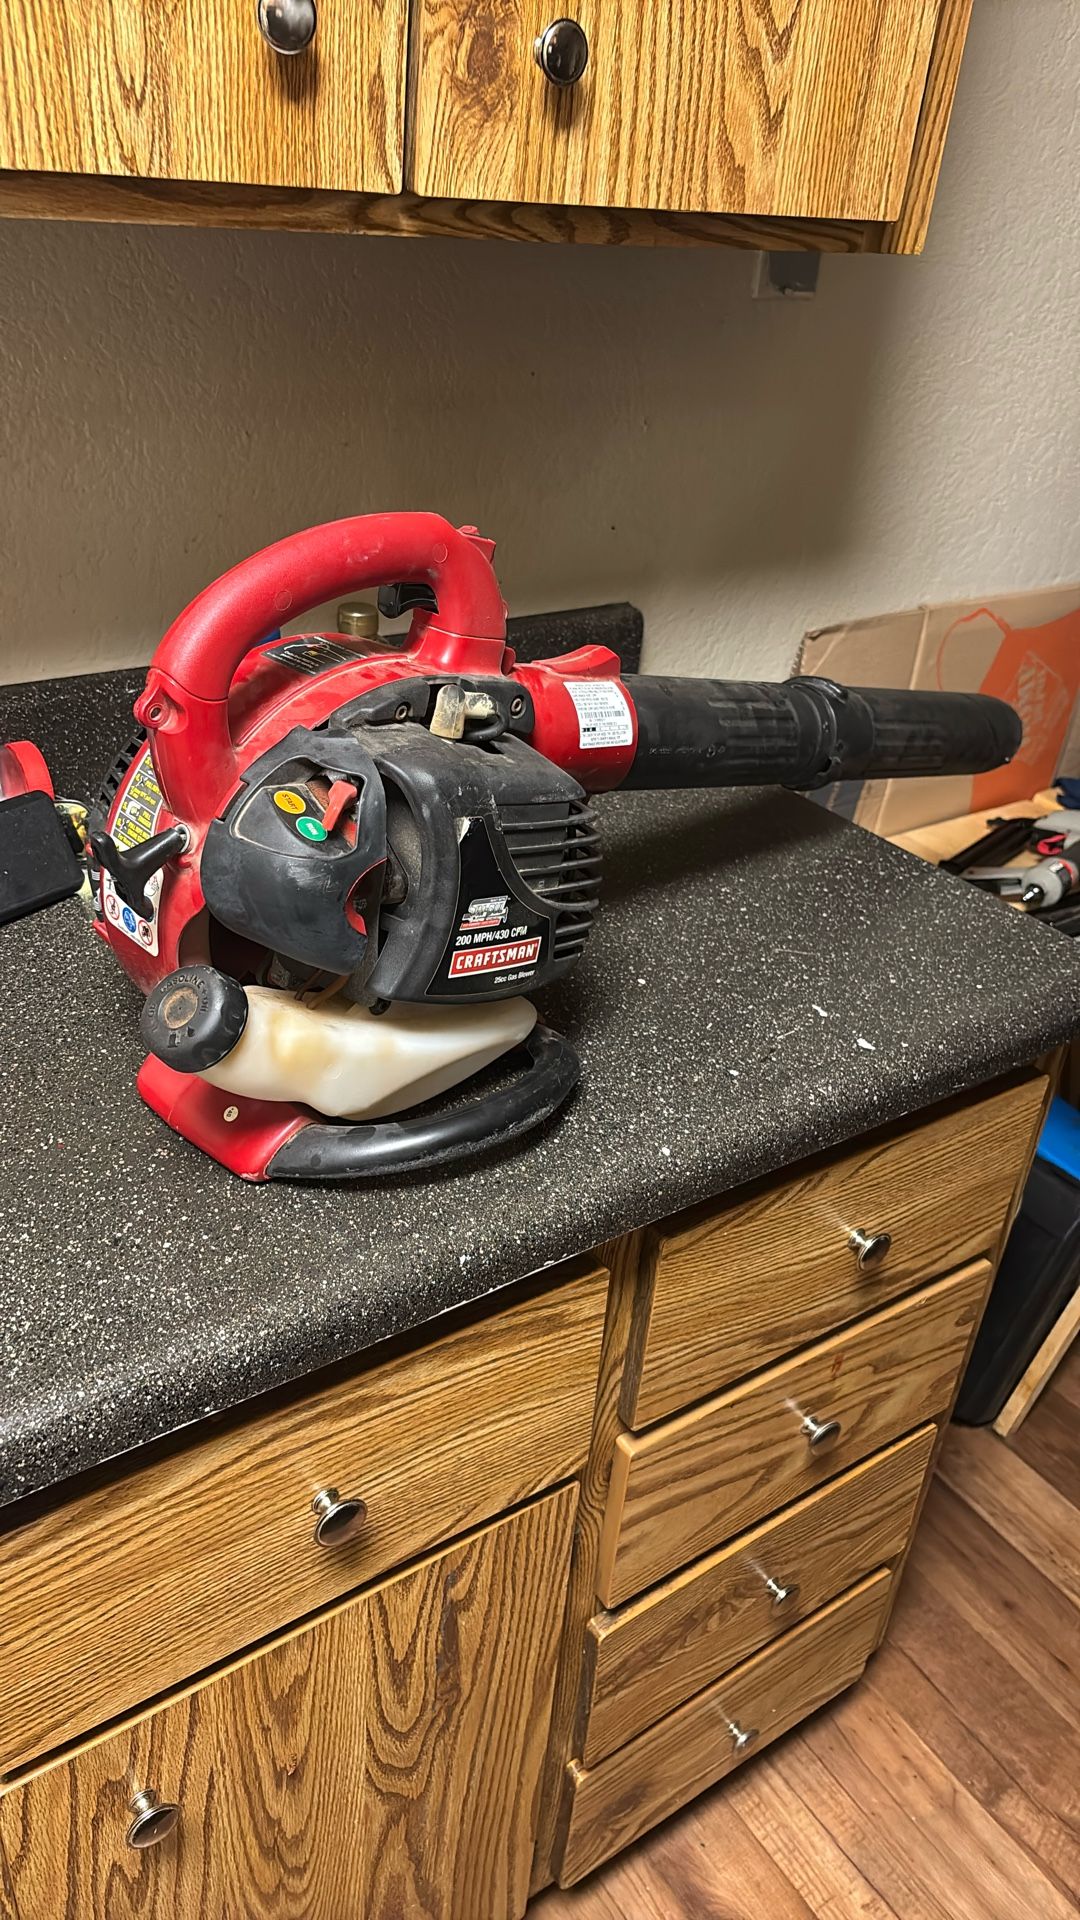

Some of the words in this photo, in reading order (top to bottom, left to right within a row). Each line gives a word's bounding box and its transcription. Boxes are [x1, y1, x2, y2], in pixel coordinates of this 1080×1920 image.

[281, 793, 299, 811] START
[455, 934, 472, 946] 200
[473, 928, 510, 944] MPH/430
[455, 943, 536, 970] CRAFTSMAN
[493, 975, 507, 984] 25cc
[507, 973, 518, 982] Gas
[517, 969, 536, 979] Blower
